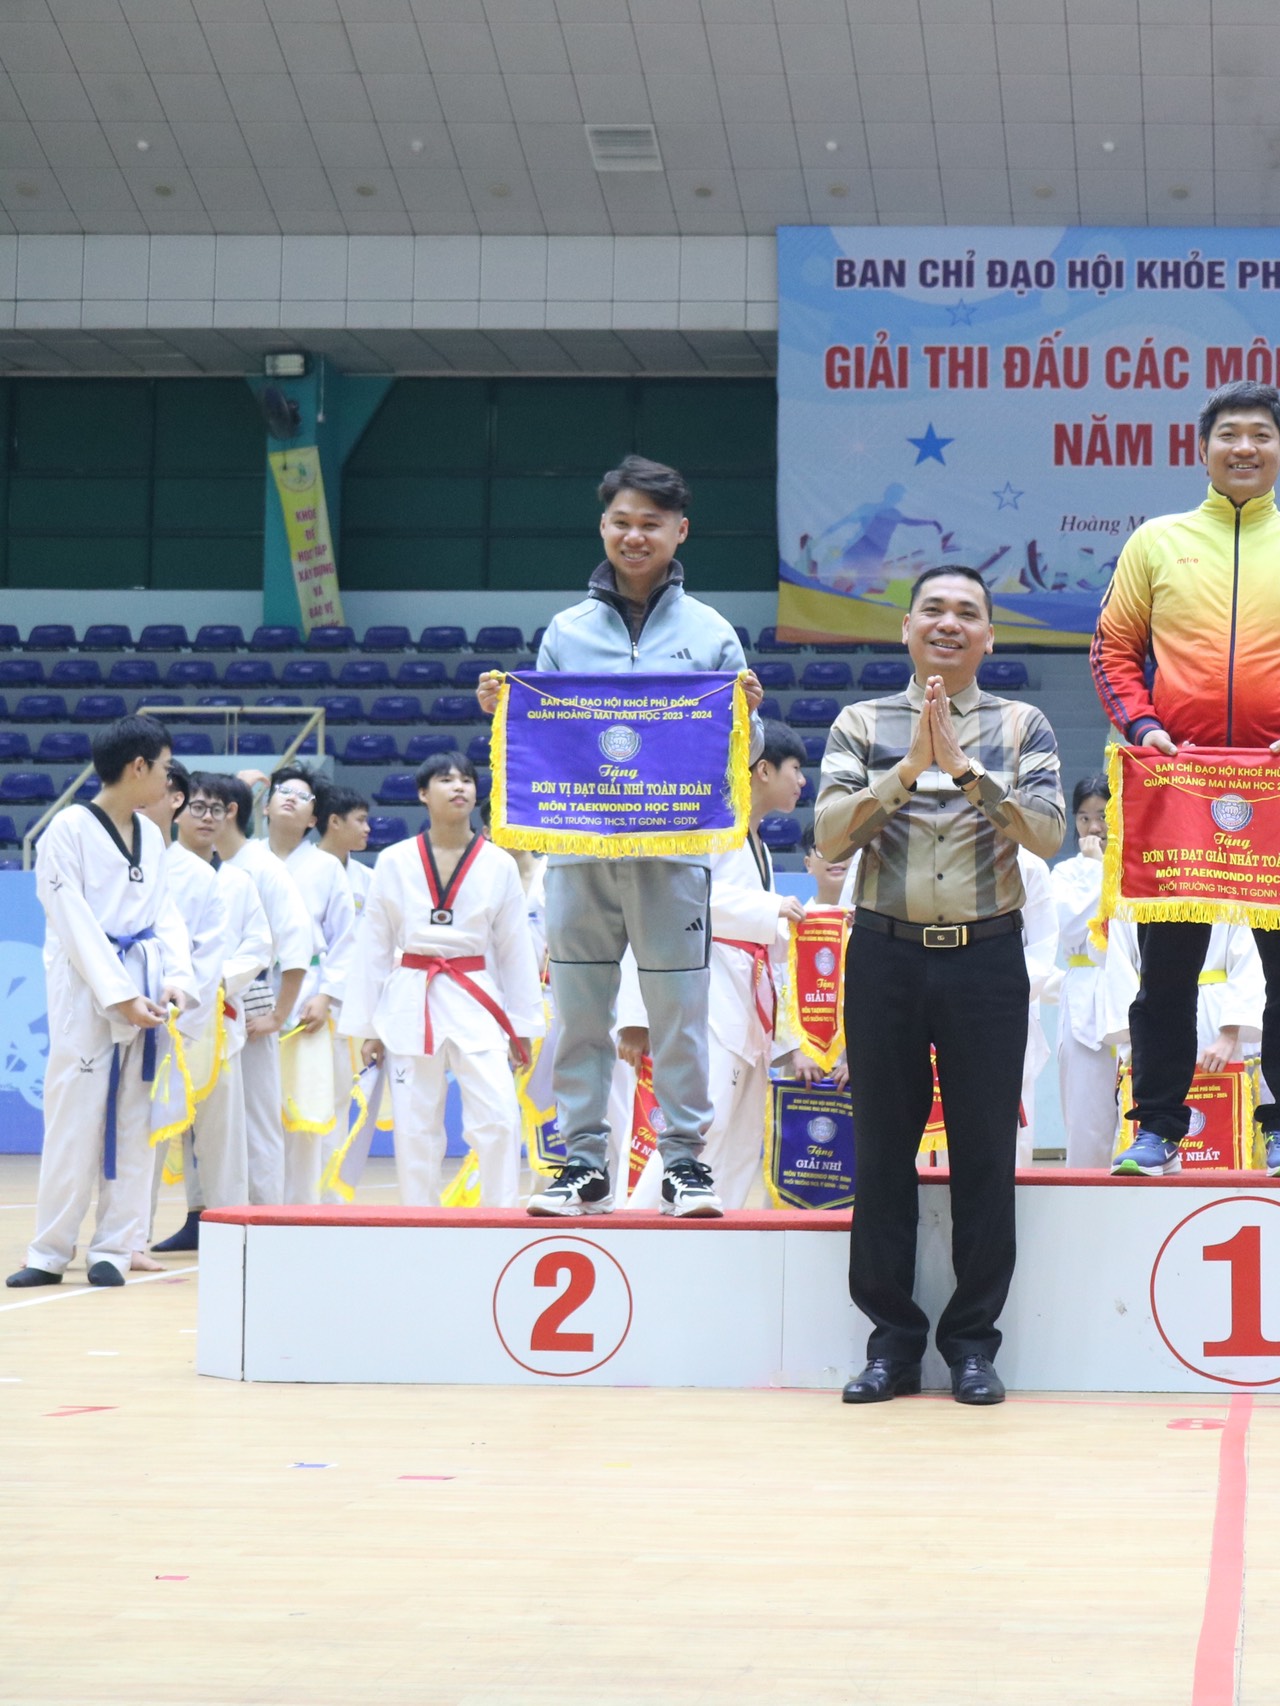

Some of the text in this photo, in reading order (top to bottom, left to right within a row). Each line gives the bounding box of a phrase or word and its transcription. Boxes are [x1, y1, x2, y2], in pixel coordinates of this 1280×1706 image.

[835, 259, 906, 289] BAN
[918, 250, 975, 289] CHỈ
[987, 259, 1055, 296] ĐẠO
[1068, 252, 1124, 296] HỘI
[1137, 250, 1225, 290] KHỎE
[825, 332, 908, 389] GIẢI
[924, 346, 988, 389] THI
[1004, 330, 1089, 389] ĐẤU
[1106, 338, 1189, 389] CÁC
[1054, 415, 1152, 466] NĂM
[1060, 515, 1120, 535] Hoàng
[527, 709, 712, 722] QUẬN HOÀNG MAI NĂM HỌC 2023 2024
[599, 764, 638, 779] Tặng
[1155, 763, 1174, 772] BAN
[1176, 762, 1192, 772] CHỈ
[1195, 766, 1216, 775] ĐẠO
[1219, 765, 1235, 777] HỘI
[531, 778, 712, 797] ĐƠN VỊ ĐẠT GIẢI NHÌ TOÀN ĐOÀN
[1143, 777, 1169, 787] QUẬN
[1172, 775, 1206, 786] HOÀNG
[1208, 779, 1226, 788] MAI
[1229, 779, 1251, 788] NĂM
[1253, 782, 1275, 792] HỌC
[538, 800, 700, 814] MÔN TAEKWONDO HỌC SINH
[541, 814, 563, 824] KHỐI
[638, 817, 666, 825] GDNN
[673, 817, 698, 825] GDTX
[1213, 832, 1251, 849] Tặng
[1142, 849, 1164, 863] ĐƠN
[1167, 849, 1178, 863] VỊ
[1181, 849, 1203, 863] ĐẠT
[1205, 846, 1227, 864] GIẢI
[1229, 850, 1259, 866] NHẤT
[1156, 866, 1180, 878] MÔN
[1184, 867, 1253, 882] TAEKWONDO
[1256, 874, 1280, 886] HỌC
[1158, 880, 1177, 891] KHỐI
[1249, 889, 1277, 897] GDNN
[807, 1145, 834, 1157] Tặng
[1186, 1148, 1220, 1162] NHẤT
[796, 1157, 842, 1172] GIẢI NHÌ
[530, 1250, 595, 1353] 2
